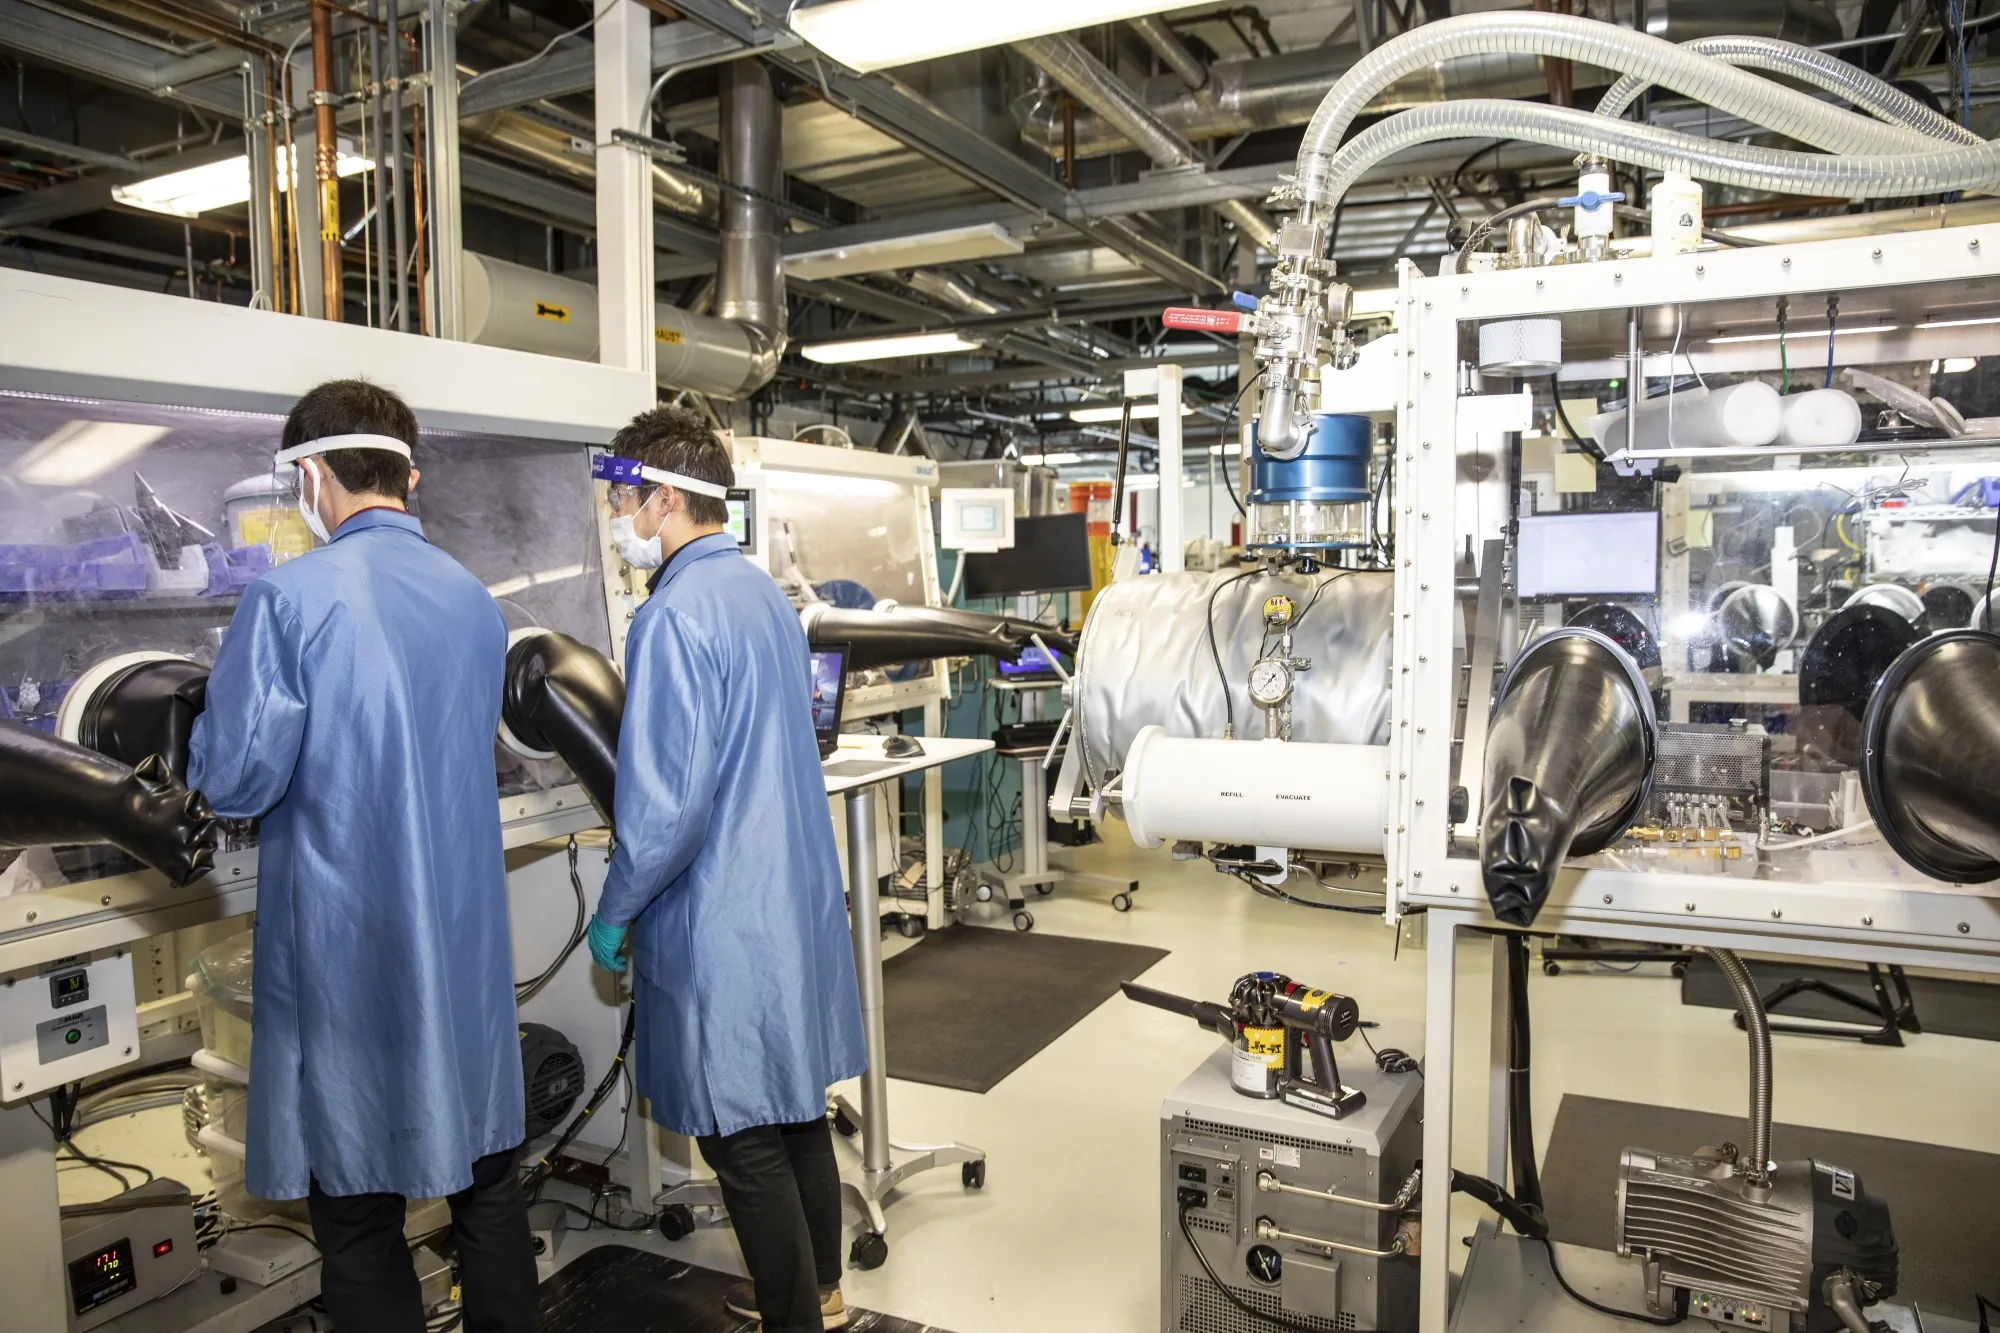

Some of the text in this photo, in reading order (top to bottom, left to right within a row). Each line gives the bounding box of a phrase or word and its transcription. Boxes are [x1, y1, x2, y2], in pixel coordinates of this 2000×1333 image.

[1275, 793, 1312, 801] EVACUATE
[97, 1250, 117, 1267] 171
[103, 1259, 119, 1271] 170
